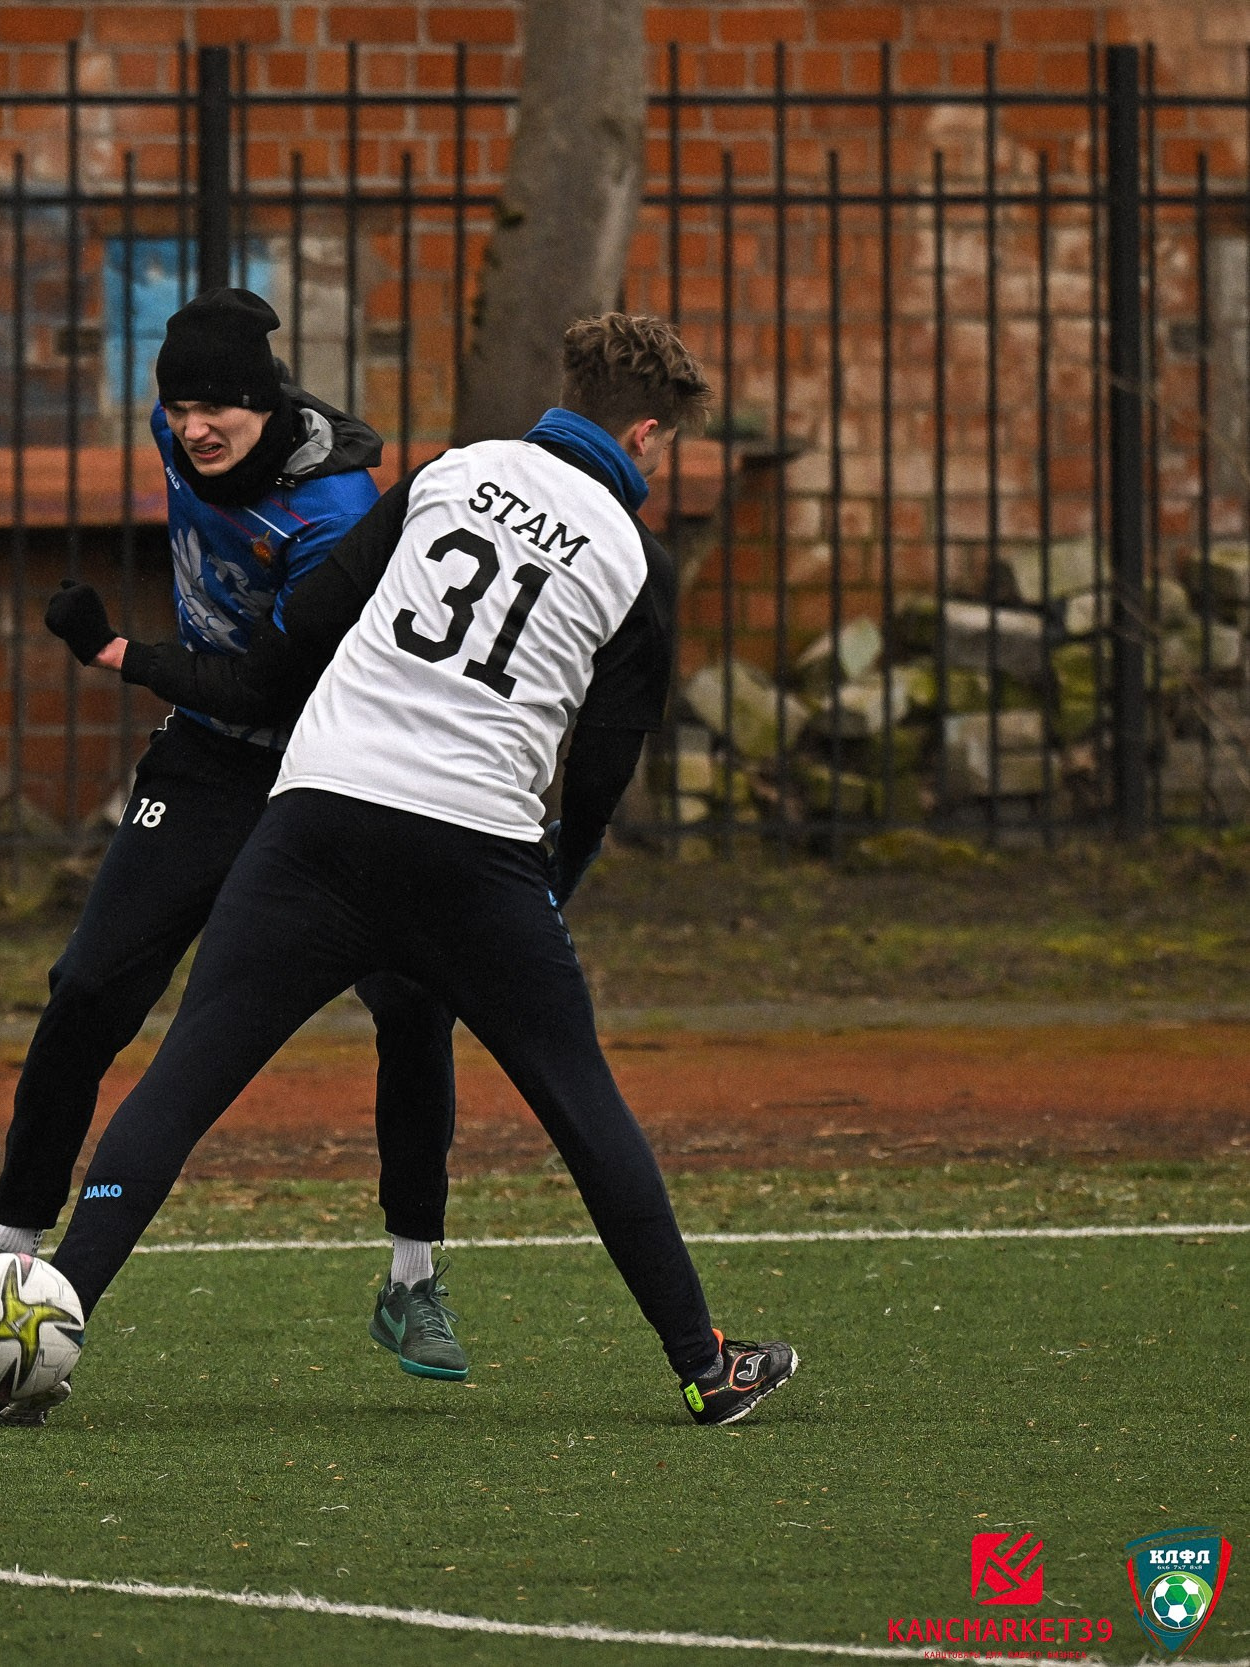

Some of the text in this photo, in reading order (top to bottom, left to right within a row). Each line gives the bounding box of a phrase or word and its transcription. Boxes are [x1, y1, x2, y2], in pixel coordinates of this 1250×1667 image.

[468, 481, 590, 567] STAM
[392, 528, 552, 700] 31
[132, 797, 166, 828] 18
[84, 1184, 123, 1200] JAKO
